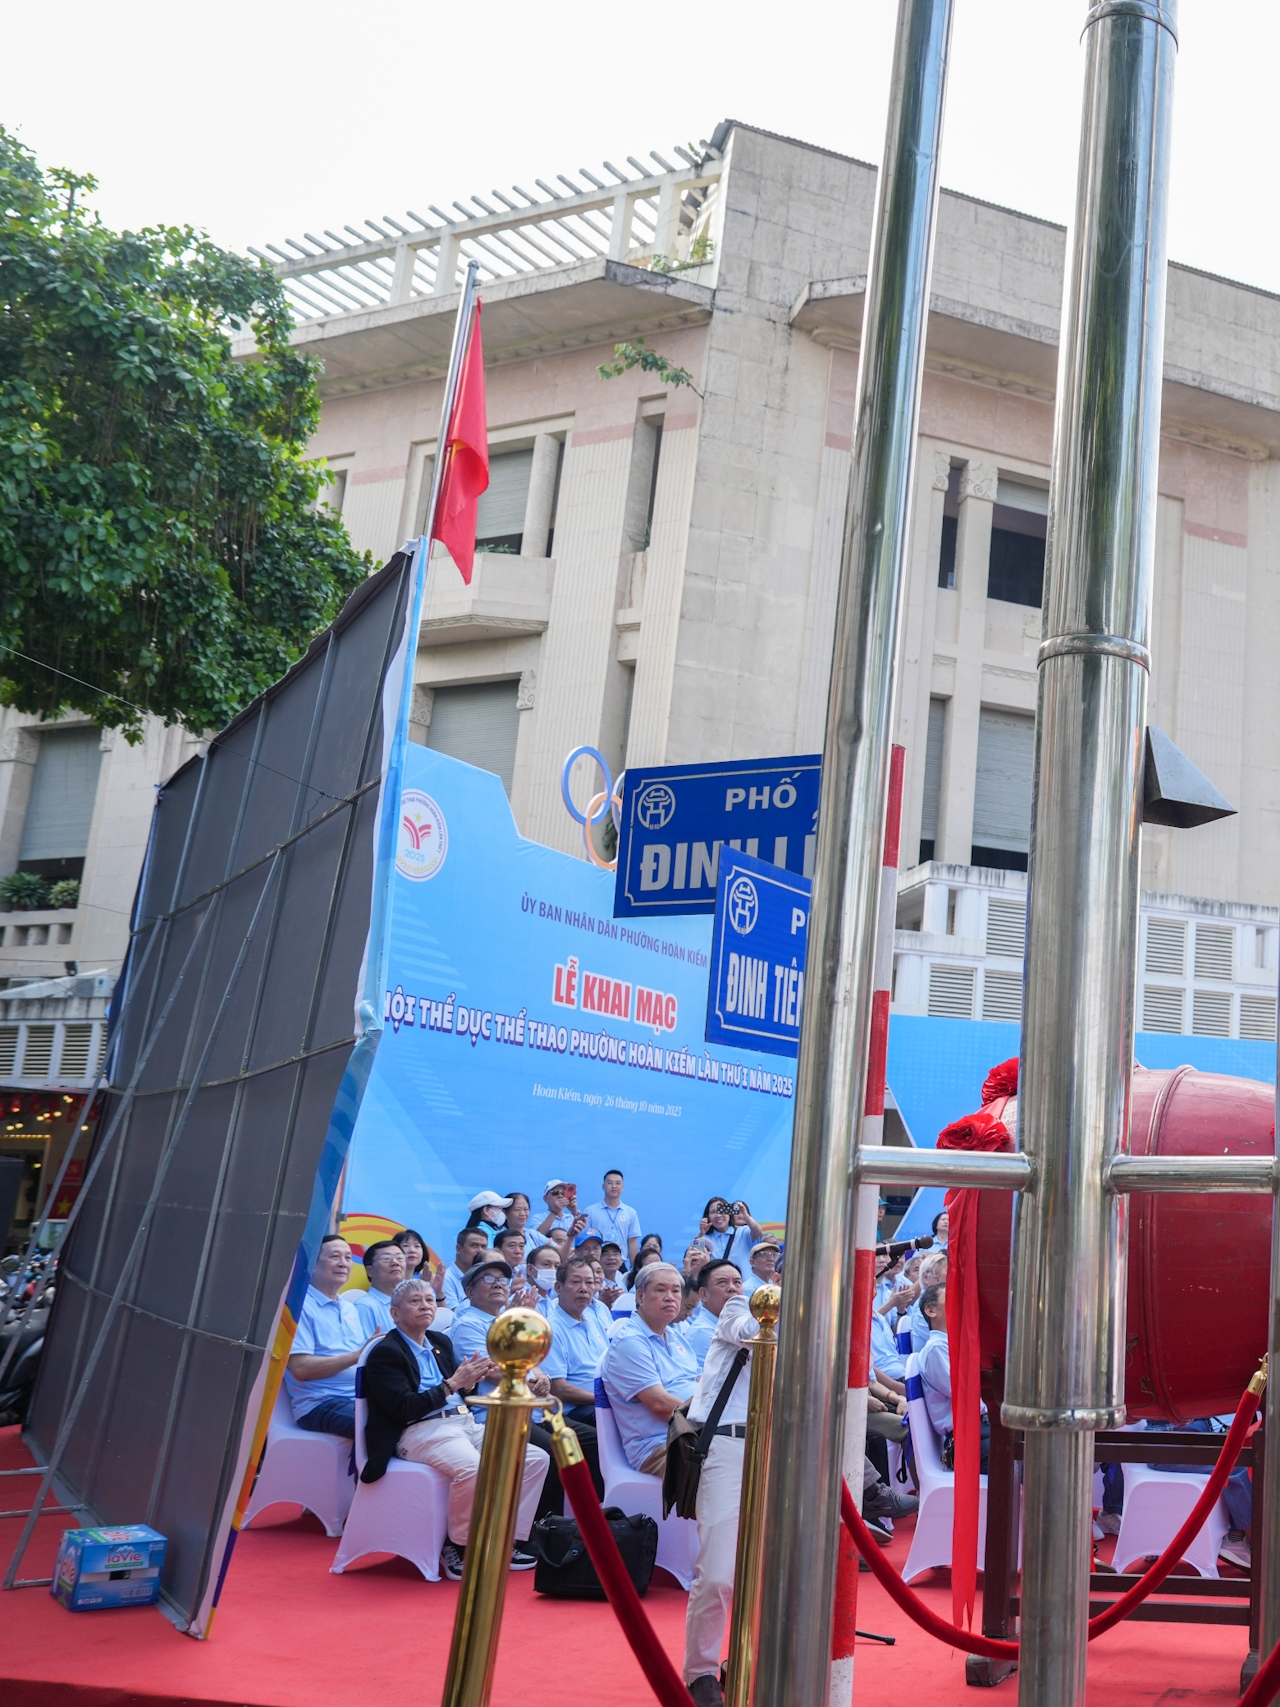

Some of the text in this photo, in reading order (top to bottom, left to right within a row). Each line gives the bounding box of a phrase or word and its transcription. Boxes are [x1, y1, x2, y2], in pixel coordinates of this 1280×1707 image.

[725, 772, 802, 812] PHỐ
[404, 849, 425, 862] 2025
[521, 892, 708, 969] ỦY BAN NHÂN DÂN PHƯỜNG HOÀN KIẾM
[553, 958, 677, 1033] LỄ KHAI MẠC
[726, 952, 769, 1020] ĐINH
[420, 992, 456, 1031] THỂ
[457, 1006, 492, 1044] DỤC
[495, 1008, 527, 1044] THỂ
[528, 1020, 568, 1052] THAO
[571, 1027, 627, 1062] PHƯỜNG
[629, 1040, 663, 1071] HOÀN
[665, 1045, 696, 1077] KIẾM
[698, 1050, 719, 1081] LẦN
[721, 1061, 743, 1086] THỨ
[742, 1066, 748, 1087] I
[749, 1065, 771, 1091] NĂM
[772, 1074, 793, 1097] 2025
[532, 1083, 557, 1099] Hoàn
[583, 1092, 603, 1107] ngày
[604, 1094, 614, 1107] 26
[615, 1096, 638, 1113] tháng
[639, 1100, 648, 1112] 10
[648, 1102, 665, 1115] năm
[665, 1104, 682, 1117] 2025
